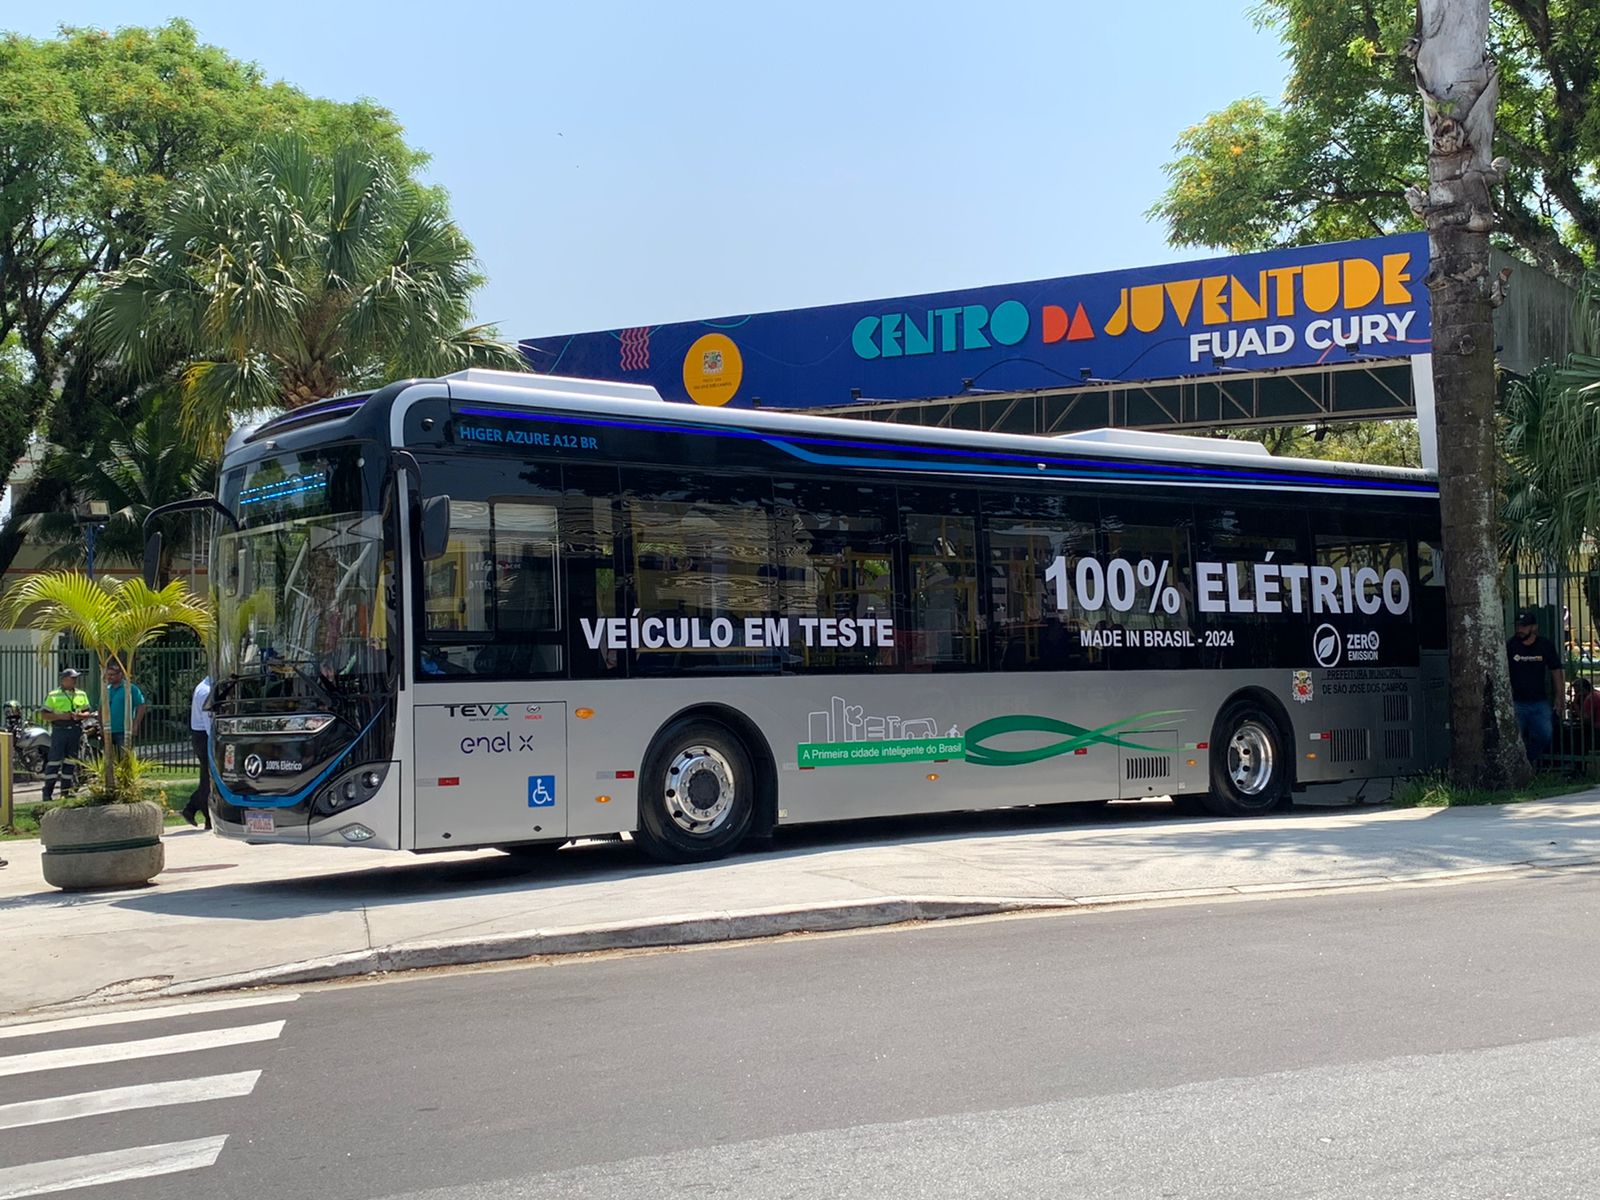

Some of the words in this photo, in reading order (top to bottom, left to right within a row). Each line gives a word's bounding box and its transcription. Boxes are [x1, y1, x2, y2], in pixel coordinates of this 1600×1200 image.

[852, 300, 1030, 359] CENTRO
[1043, 302, 1095, 343] DA
[1104, 252, 1413, 337] JUVENTUDE
[1190, 323, 1295, 362] FUAD
[1305, 311, 1416, 350] CURY
[460, 426, 503, 442] HIGER
[506, 430, 551, 446] AZURE
[553, 434, 578, 448] A12
[580, 437, 599, 450] BR
[1045, 555, 1180, 615] 100%
[1196, 551, 1410, 615] ELÉTRICO
[580, 608, 733, 649] VEÍCULO
[744, 618, 789, 647] EM
[799, 618, 894, 647] TESTE
[1080, 630, 1122, 647] MADE
[1126, 630, 1139, 647] IN
[1144, 630, 1195, 647] BRASIL
[1205, 631, 1235, 647] 2024
[1347, 631, 1380, 650] ZERO
[1348, 651, 1379, 661] EMISSION
[1322, 684, 1332, 694] DE
[444, 704, 509, 717] TEVX
[461, 731, 511, 754] enel
[802, 750, 811, 760] A
[812, 749, 849, 760] Primeira
[851, 747, 880, 758] cidade
[882, 745, 924, 758] inteligente
[926, 744, 937, 754] do
[939, 743, 962, 753] Brasil
[266, 760, 280, 770] 100%
[280, 760, 303, 770] Elétrico
